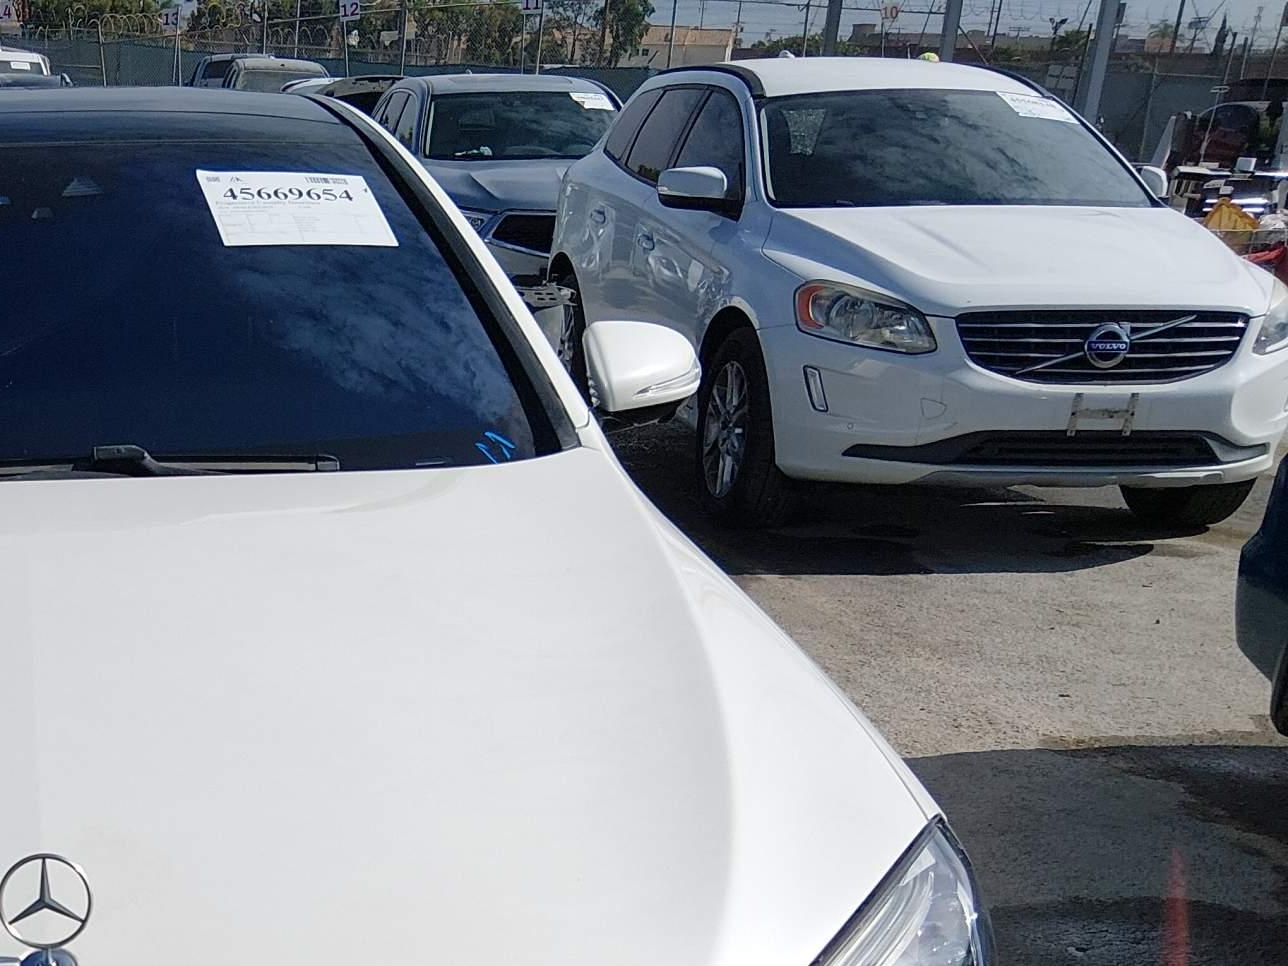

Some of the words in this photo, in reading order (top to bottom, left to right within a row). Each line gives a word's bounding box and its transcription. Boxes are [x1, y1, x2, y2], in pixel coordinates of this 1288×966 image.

[341, 2, 359, 17] 12
[881, 6, 899, 20] 10
[162, 11, 179, 26] 13
[223, 187, 354, 202] 45669654
